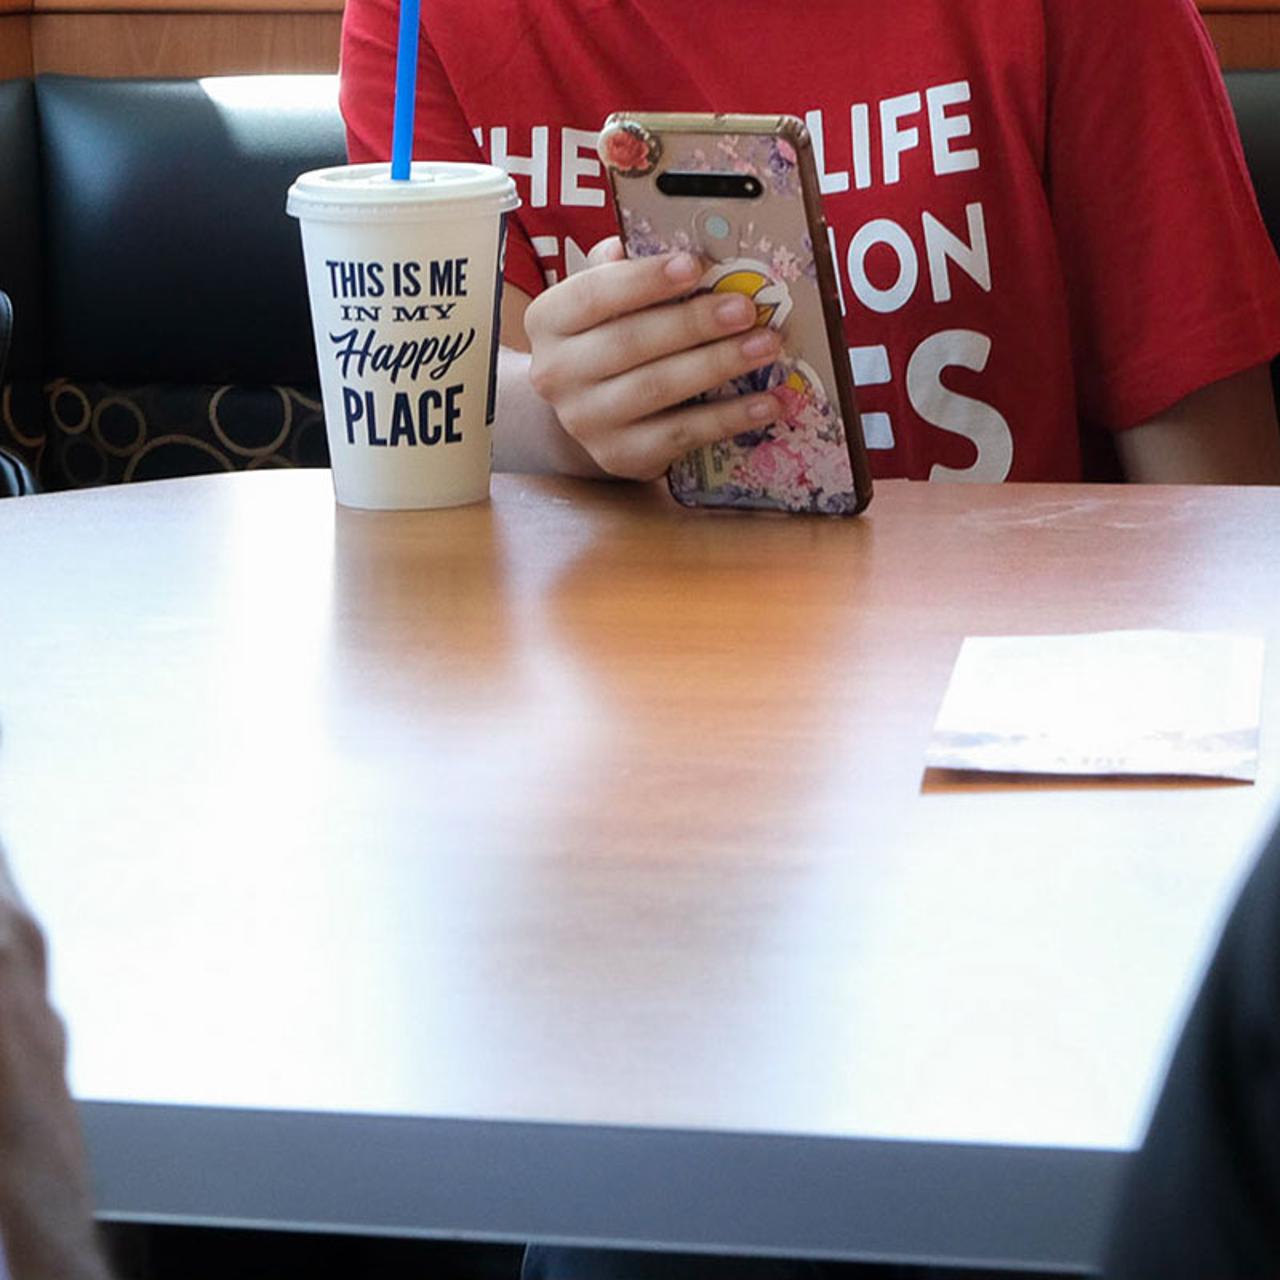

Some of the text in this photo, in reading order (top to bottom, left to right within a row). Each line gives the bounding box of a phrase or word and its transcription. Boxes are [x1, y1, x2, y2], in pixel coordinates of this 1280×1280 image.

[472, 126, 606, 208] HE
[325, 258, 468, 298] THIS IS ME
[340, 303, 456, 321] IN MY
[329, 328, 475, 384] Happy
[343, 384, 464, 447] PLACE
